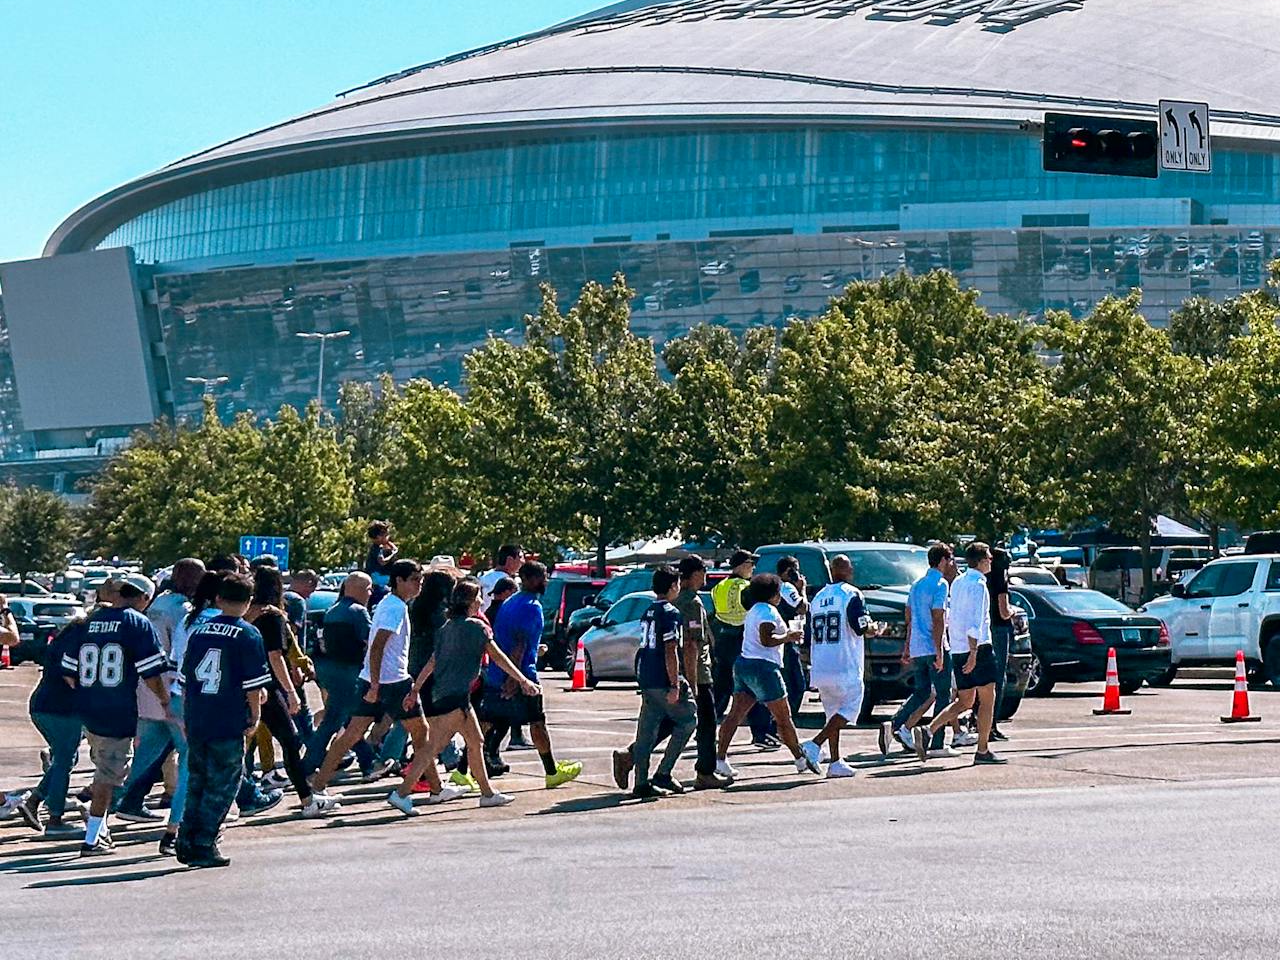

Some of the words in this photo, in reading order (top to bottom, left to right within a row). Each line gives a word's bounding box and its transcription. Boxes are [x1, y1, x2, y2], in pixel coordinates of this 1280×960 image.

[1165, 150, 1183, 164] ONLY
[1188, 151, 1207, 165] ONLY
[79, 642, 124, 688] 88
[195, 648, 222, 694] 4
